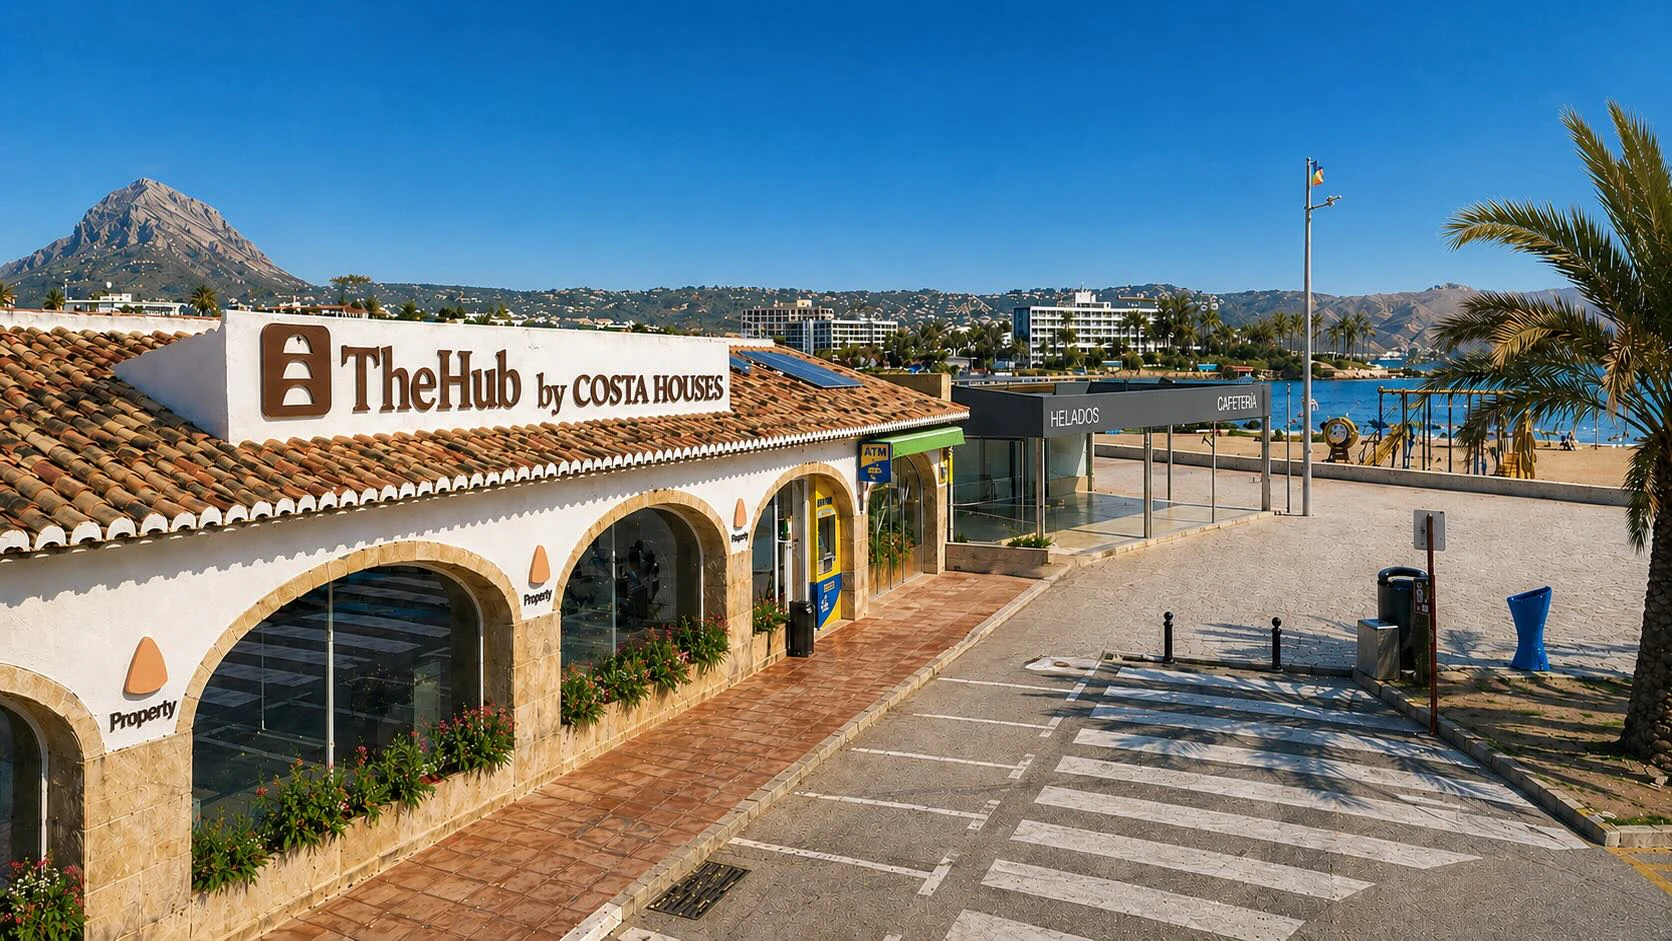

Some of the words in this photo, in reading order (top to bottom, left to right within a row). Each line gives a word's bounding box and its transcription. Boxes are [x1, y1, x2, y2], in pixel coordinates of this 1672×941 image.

[341, 345, 522, 413] TheHub
[536, 372, 567, 416] by
[573, 374, 648, 408] COSTA
[653, 374, 724, 404] HOUSES
[1217, 392, 1257, 411] CAFETERÍA
[1050, 407, 1099, 427] HELADOS
[864, 447, 886, 457] ATM
[523, 589, 552, 606] Property
[109, 700, 177, 733] Property
